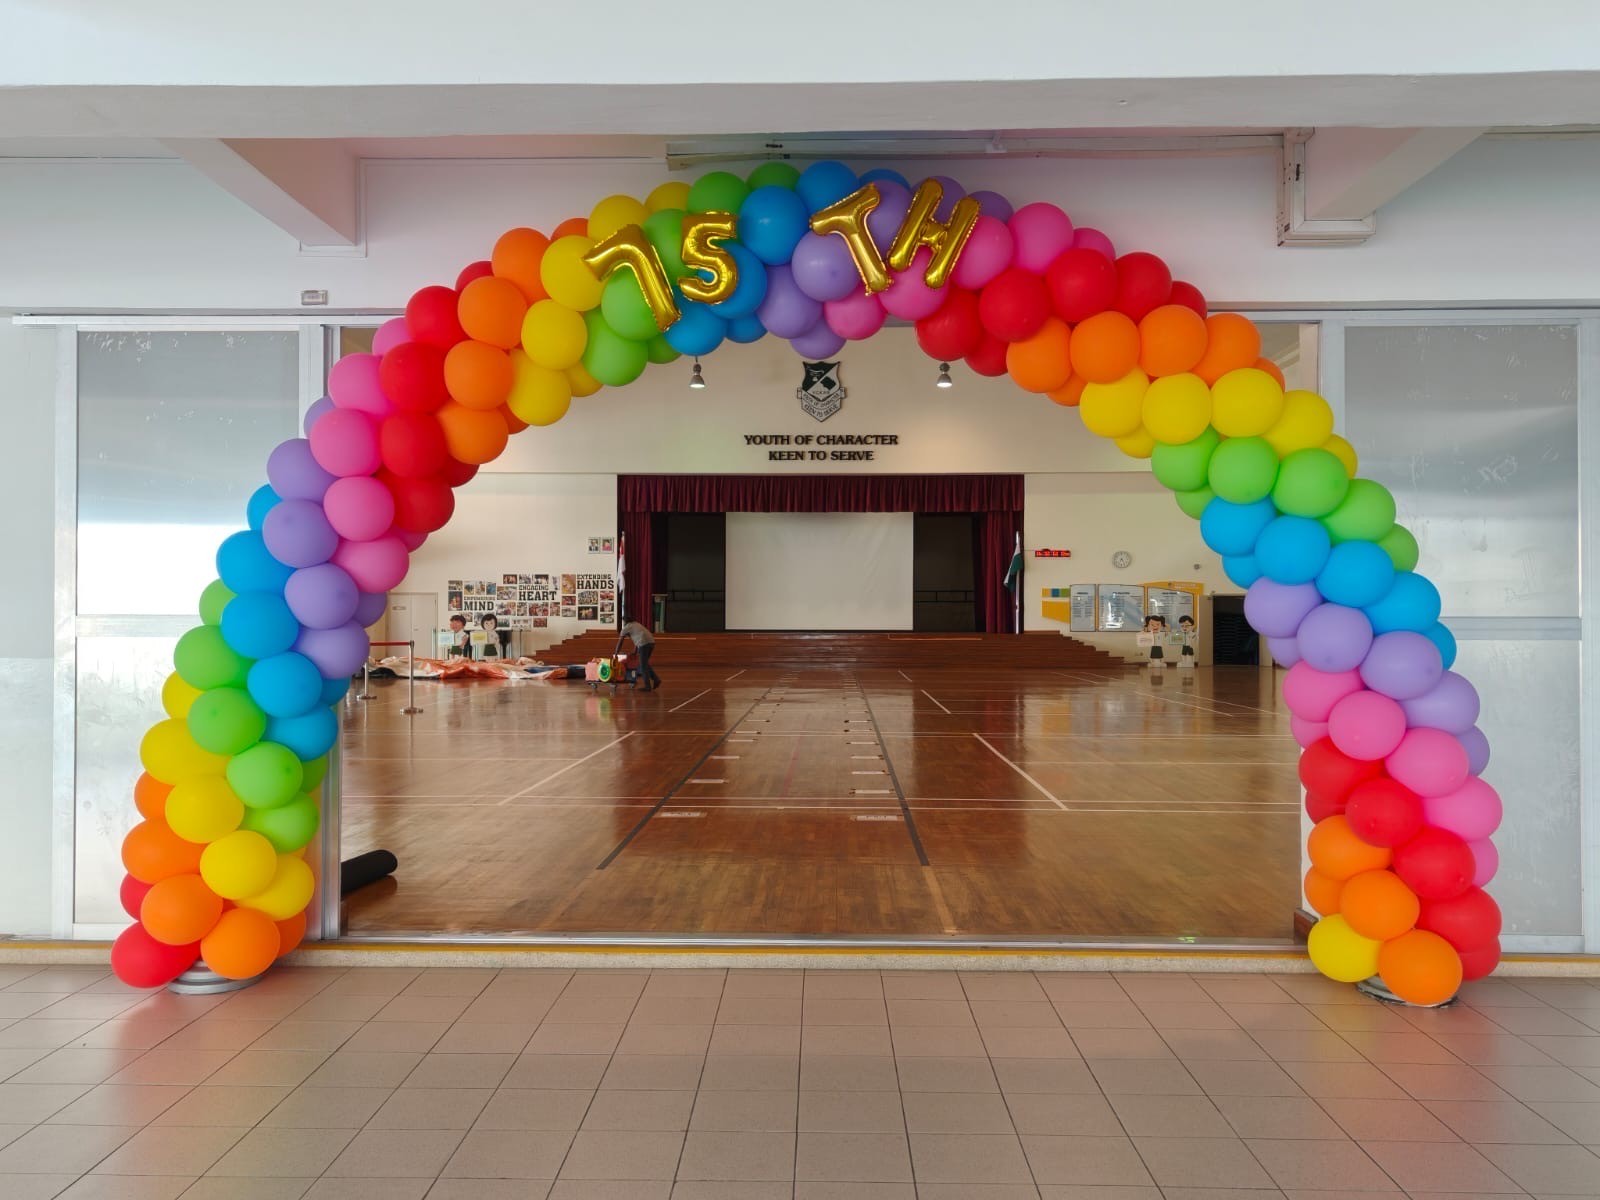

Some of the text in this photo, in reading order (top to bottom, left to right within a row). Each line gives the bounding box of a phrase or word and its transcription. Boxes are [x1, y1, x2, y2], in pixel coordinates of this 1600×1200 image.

[583, 178, 981, 332] 75 TH
[744, 434, 899, 446] YOUTH OF CHARACTER
[768, 450, 875, 461] KEEN TO SERVE
[576, 580, 614, 590] HANDS
[518, 591, 557, 601] HEART
[463, 601, 495, 611] MIND
